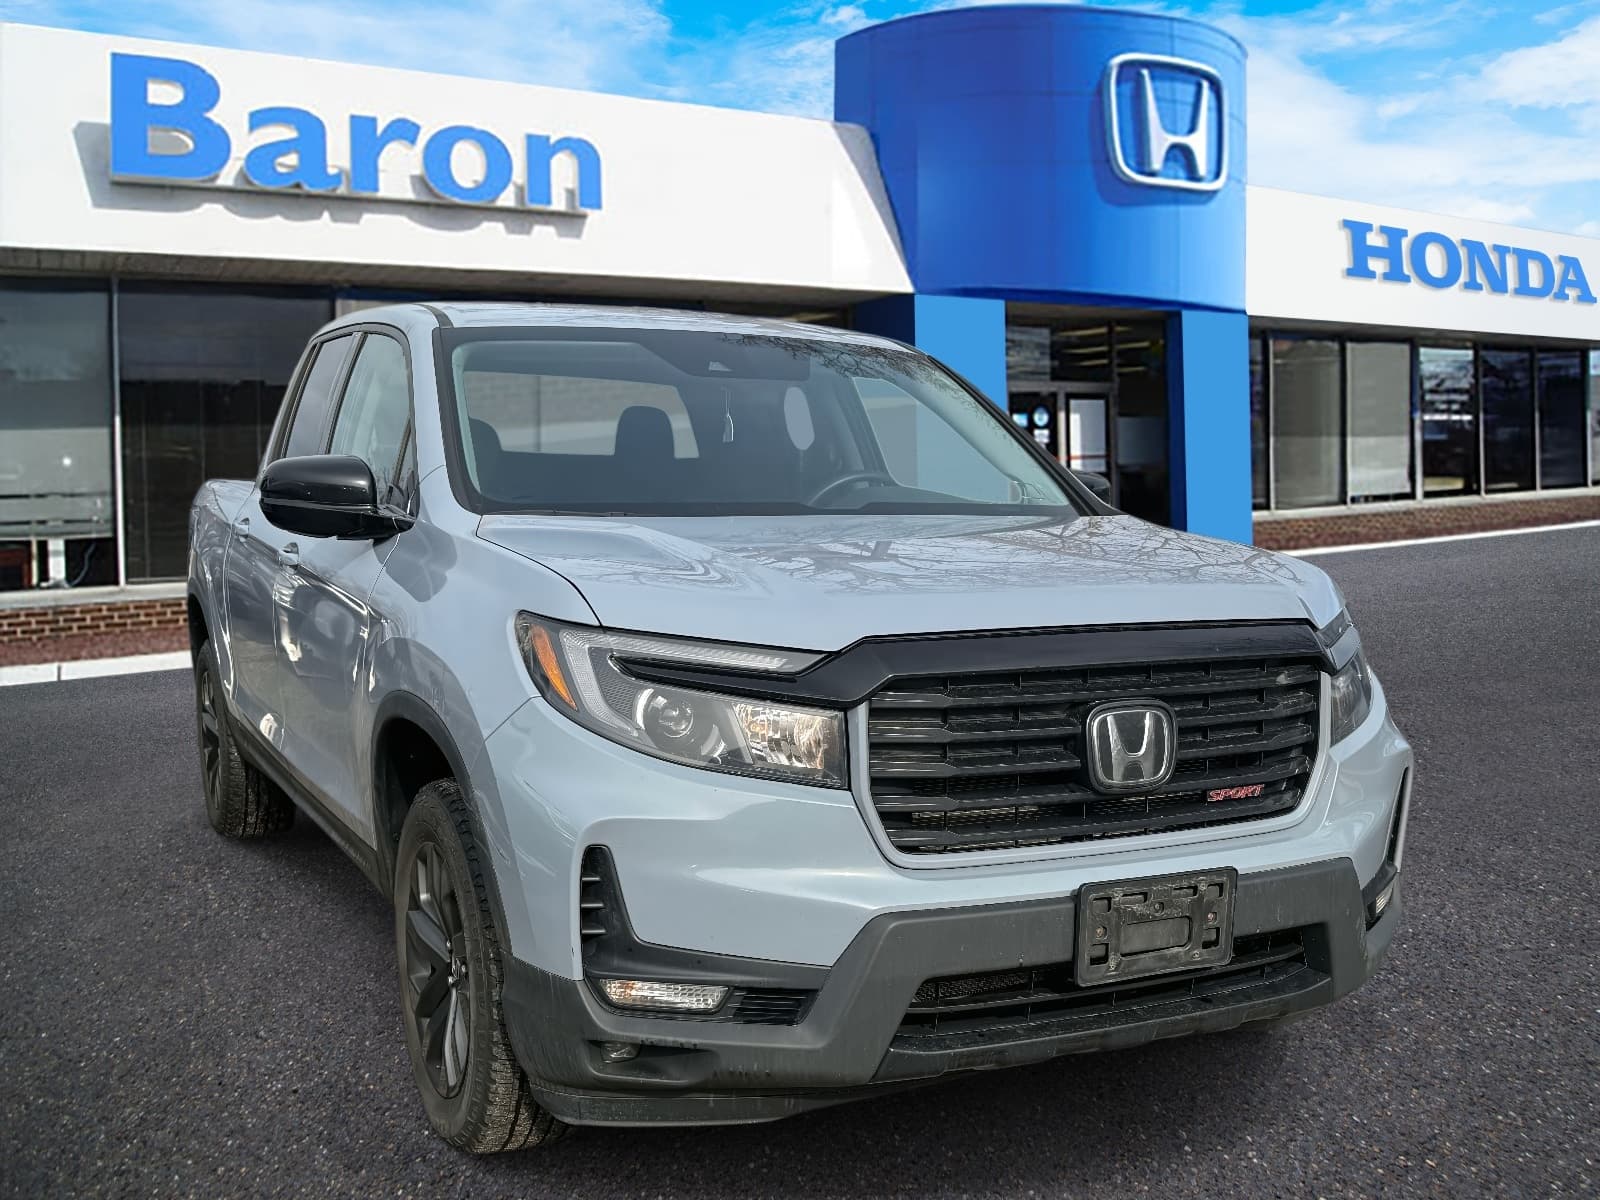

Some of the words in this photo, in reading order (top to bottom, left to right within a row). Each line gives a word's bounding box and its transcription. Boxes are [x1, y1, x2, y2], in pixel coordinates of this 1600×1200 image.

[110, 52, 603, 211] Baron
[1342, 218, 1598, 304] HONDA
[1207, 783, 1265, 802] SPORT
